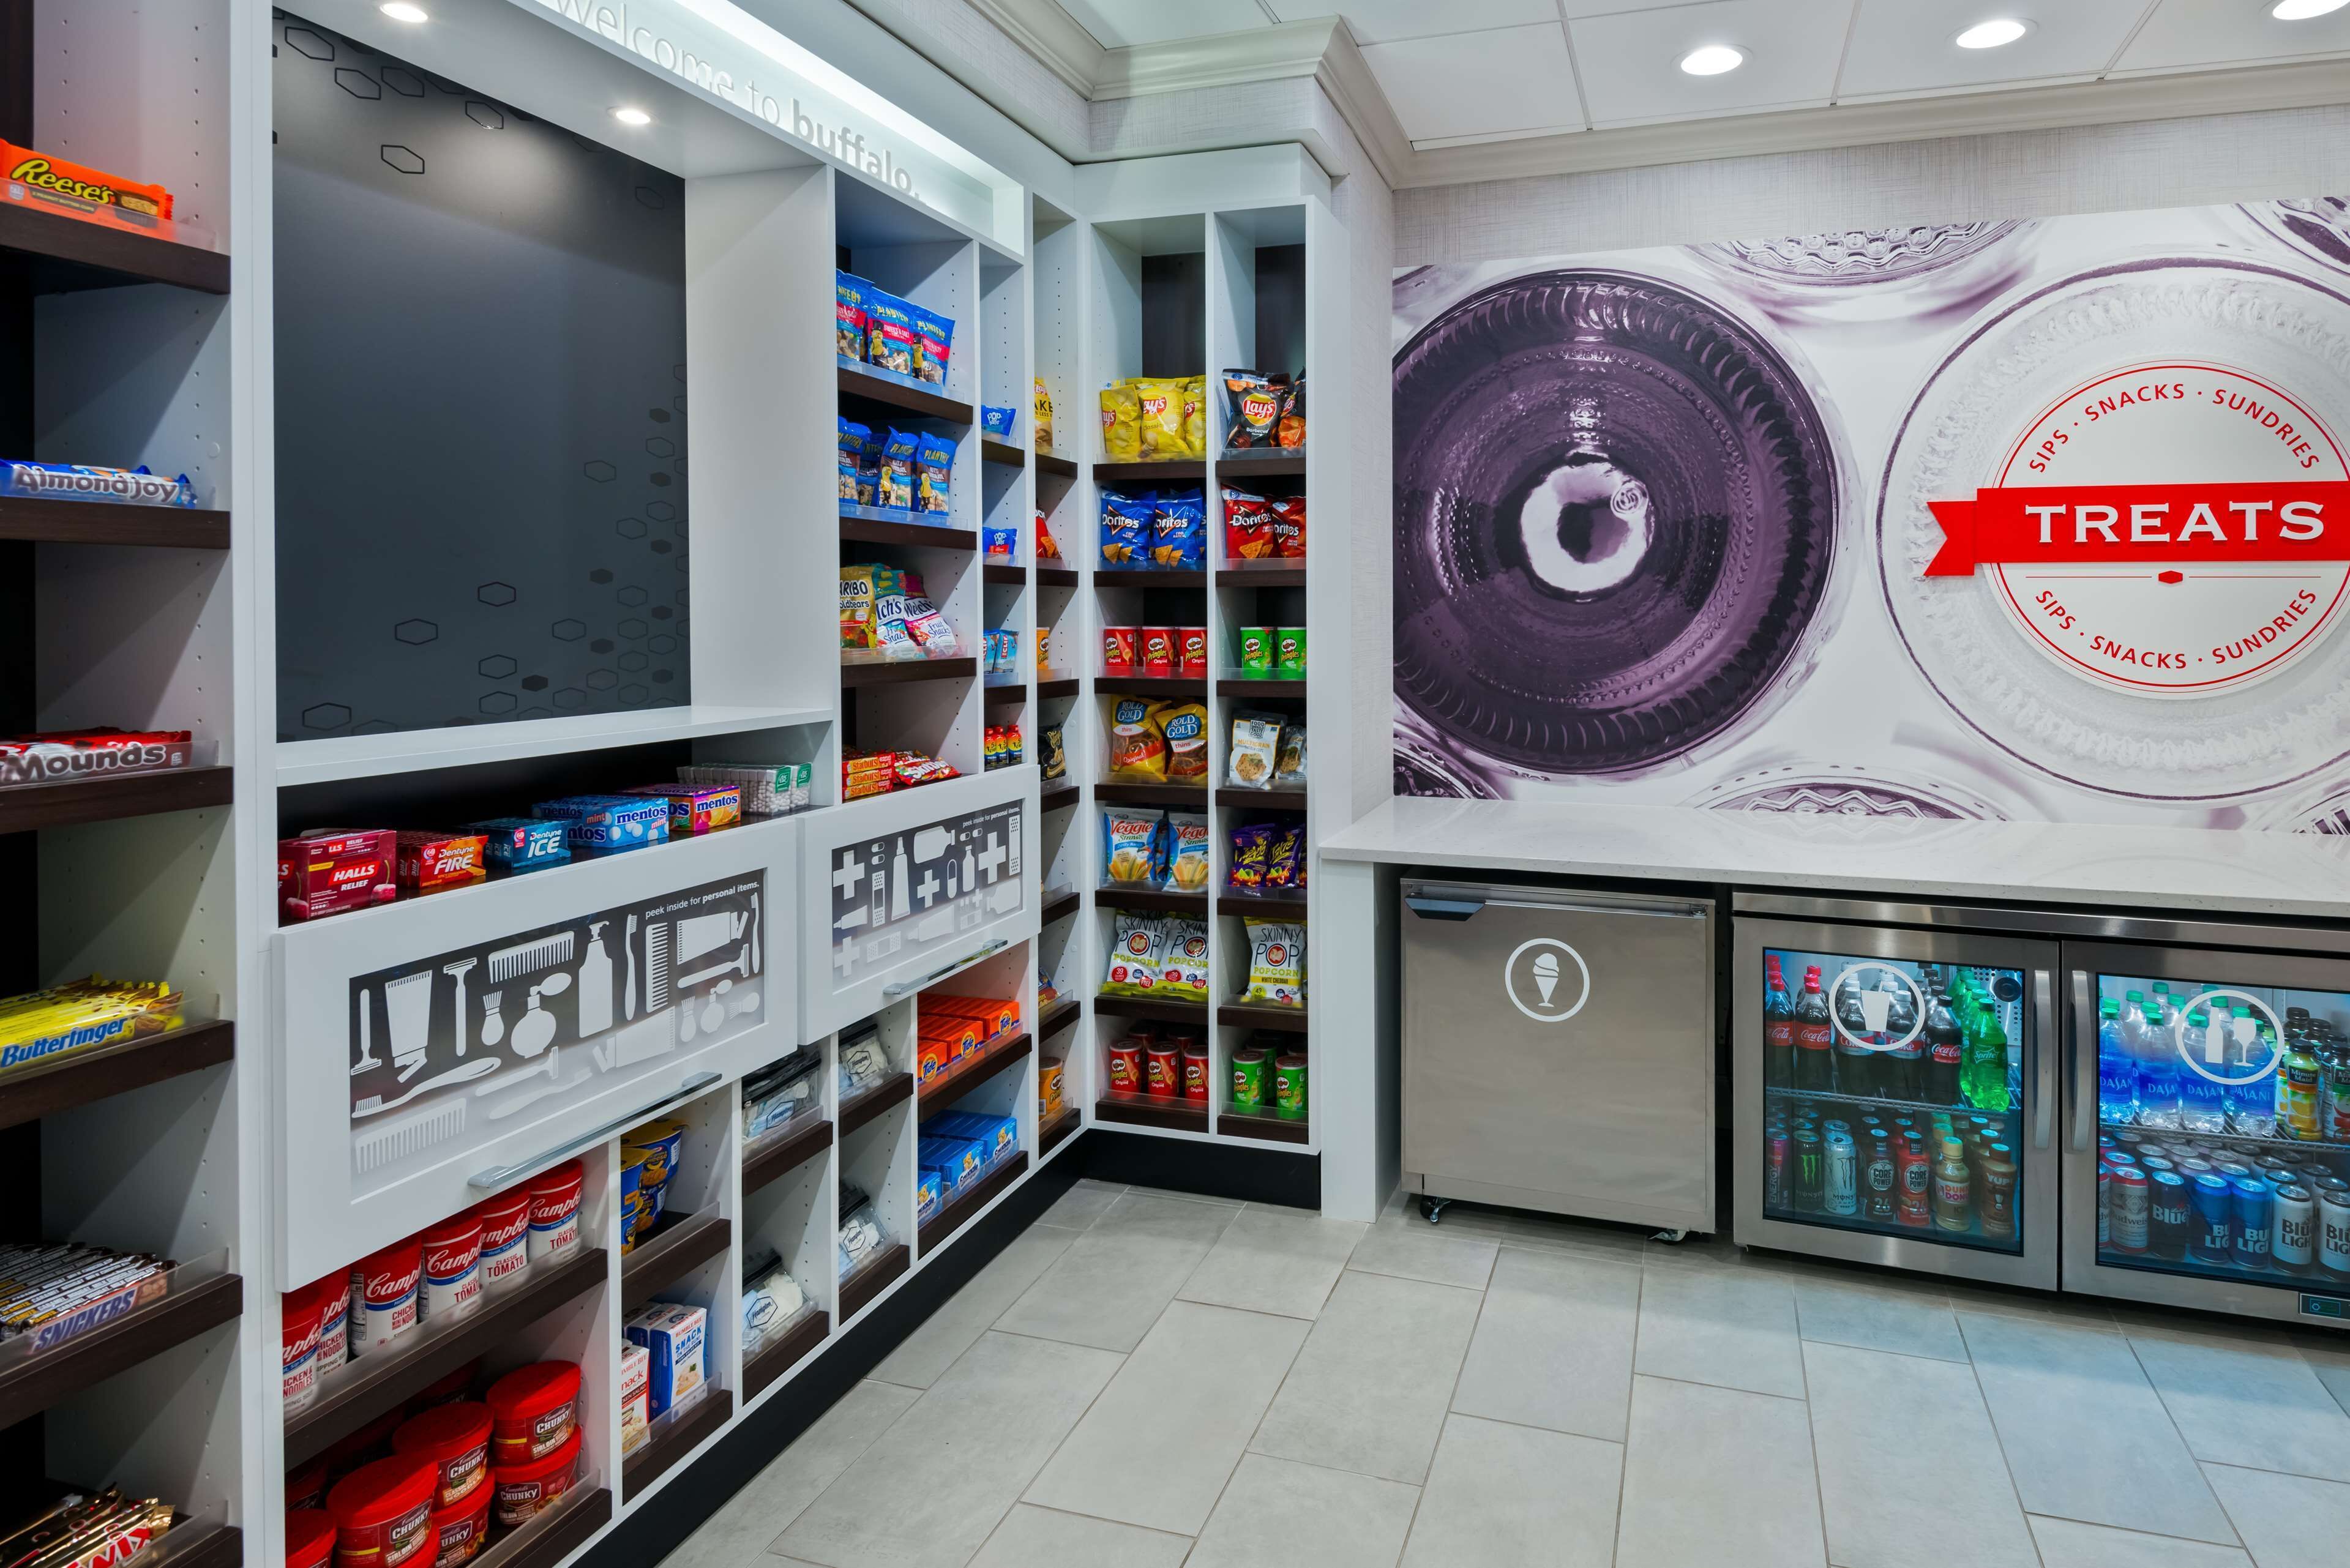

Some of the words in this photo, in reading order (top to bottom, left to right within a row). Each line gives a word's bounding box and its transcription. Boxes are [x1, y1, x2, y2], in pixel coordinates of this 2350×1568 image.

[555, 0, 735, 99] welcome
[745, 80, 780, 126] to
[791, 97, 926, 206] buffalo.
[10, 159, 115, 204] Reese's
[1244, 398, 1275, 420] Lay's
[2029, 428, 2070, 472] SIPS
[2084, 383, 2185, 422] SNACKS
[2212, 388, 2320, 469] SUNDRIES
[1102, 514, 1139, 528] Doritos
[1154, 517, 1188, 529] oritos
[2024, 500, 2325, 543] TREATS
[1274, 524, 1299, 536] oritos
[840, 580, 869, 597] ARIBO
[840, 600, 870, 610] oldbears
[876, 599, 902, 620] lch's
[928, 621, 944, 631] Fruit
[928, 627, 950, 638] Snacks
[2035, 589, 2076, 631] SIPS
[2089, 635, 2188, 670] SNACKS
[2211, 589, 2317, 664] SUNDRIES
[1148, 650, 1167, 662] Pringles
[1186, 649, 1205, 662] Pringles
[1244, 649, 1263, 662] Pringles
[1281, 651, 1299, 663] Pringles
[1117, 709, 1142, 722] GOLD
[1166, 723, 1198, 739] GOLD
[2, 741, 166, 782] Mounds
[853, 757, 880, 770] Starburst
[853, 769, 880, 784] Starburst
[851, 782, 878, 795] Starburst
[542, 806, 584, 816] mentos
[696, 795, 738, 812] mentos
[586, 813, 606, 824] mint
[616, 805, 668, 825] mentos
[651, 816, 667, 829] mint
[962, 818, 973, 828] peek
[990, 808, 1008, 820] personal
[567, 824, 606, 842] ntos
[1110, 819, 1154, 835] Veggie
[1177, 826, 1208, 840] Vegg
[529, 829, 562, 842] Dentyne
[438, 846, 474, 859] Dentyne
[527, 837, 561, 858] ICE
[433, 854, 474, 875] FIRE
[333, 864, 375, 882] HALLS
[340, 879, 369, 892] RELIEF
[645, 906, 664, 920] peek
[666, 898, 688, 913] inside
[690, 896, 701, 906] for
[702, 887, 736, 904] personal
[737, 881, 760, 893] items.
[1124, 917, 1168, 935] SKINNY
[1260, 927, 1302, 944] SKINNY
[1115, 930, 1162, 958] POP
[1113, 953, 1160, 968] POPCORN
[1168, 957, 1208, 968] POPCOR
[1255, 943, 1300, 968] POP
[1254, 966, 1298, 977] POPCORN
[1000, 1016, 1011, 1034] Tide
[1, 1017, 128, 1068] Butterfinger
[962, 1037, 975, 1055] Tide
[1974, 1051, 1996, 1059] Sprite
[923, 1061, 937, 1080] Tide
[2291, 1068, 2316, 1078] Minute
[2100, 1076, 2132, 1091] DASAN
[2148, 1082, 2177, 1096] DASA
[2187, 1084, 2223, 1098] DASAN
[1873, 1168, 1892, 1179] CORE
[1873, 1176, 1892, 1186] POWER
[1909, 1170, 1927, 1180] CORE
[1769, 1165, 1778, 1203] ENERGY
[1909, 1179, 1926, 1188] POWER
[1874, 1197, 1890, 1212] 26
[1910, 1200, 1926, 1215] 26
[2114, 1213, 2148, 1225] udweis
[2282, 1218, 2310, 1236] Blu
[550, 1227, 577, 1249] TOMAT
[2213, 1224, 2229, 1237] BU
[2245, 1228, 2269, 1241] BU
[2326, 1223, 2350, 1243] Blu
[2205, 1234, 2229, 1249] LIG
[2281, 1233, 2311, 1249] LIGH
[487, 1255, 524, 1278] TOMATO
[496, 1253, 518, 1266] CLASSIC
[34, 1288, 137, 1349] SNICKERS
[392, 1302, 416, 1320] CHICKE
[751, 1301, 773, 1323] Hampton
[675, 1323, 694, 1338] BUMBLE
[694, 1316, 702, 1326] BEE
[318, 1333, 343, 1351] HICKEN
[675, 1325, 702, 1354] SNACK
[316, 1357, 338, 1372] IPPING
[621, 1362, 637, 1375] MBLE
[283, 1370, 307, 1387] ICKEN
[283, 1375, 313, 1398] NOODLES
[621, 1370, 643, 1391] nack
[536, 1408, 570, 1434] CHUNKY
[533, 1438, 555, 1455] SIRLOIN
[450, 1449, 485, 1478] CHUNKY
[500, 1488, 537, 1501] CHUNKY
[391, 1507, 430, 1539] CHUNKY
[441, 1528, 469, 1547] UNKY
[387, 1542, 412, 1564] SIRLOIN
